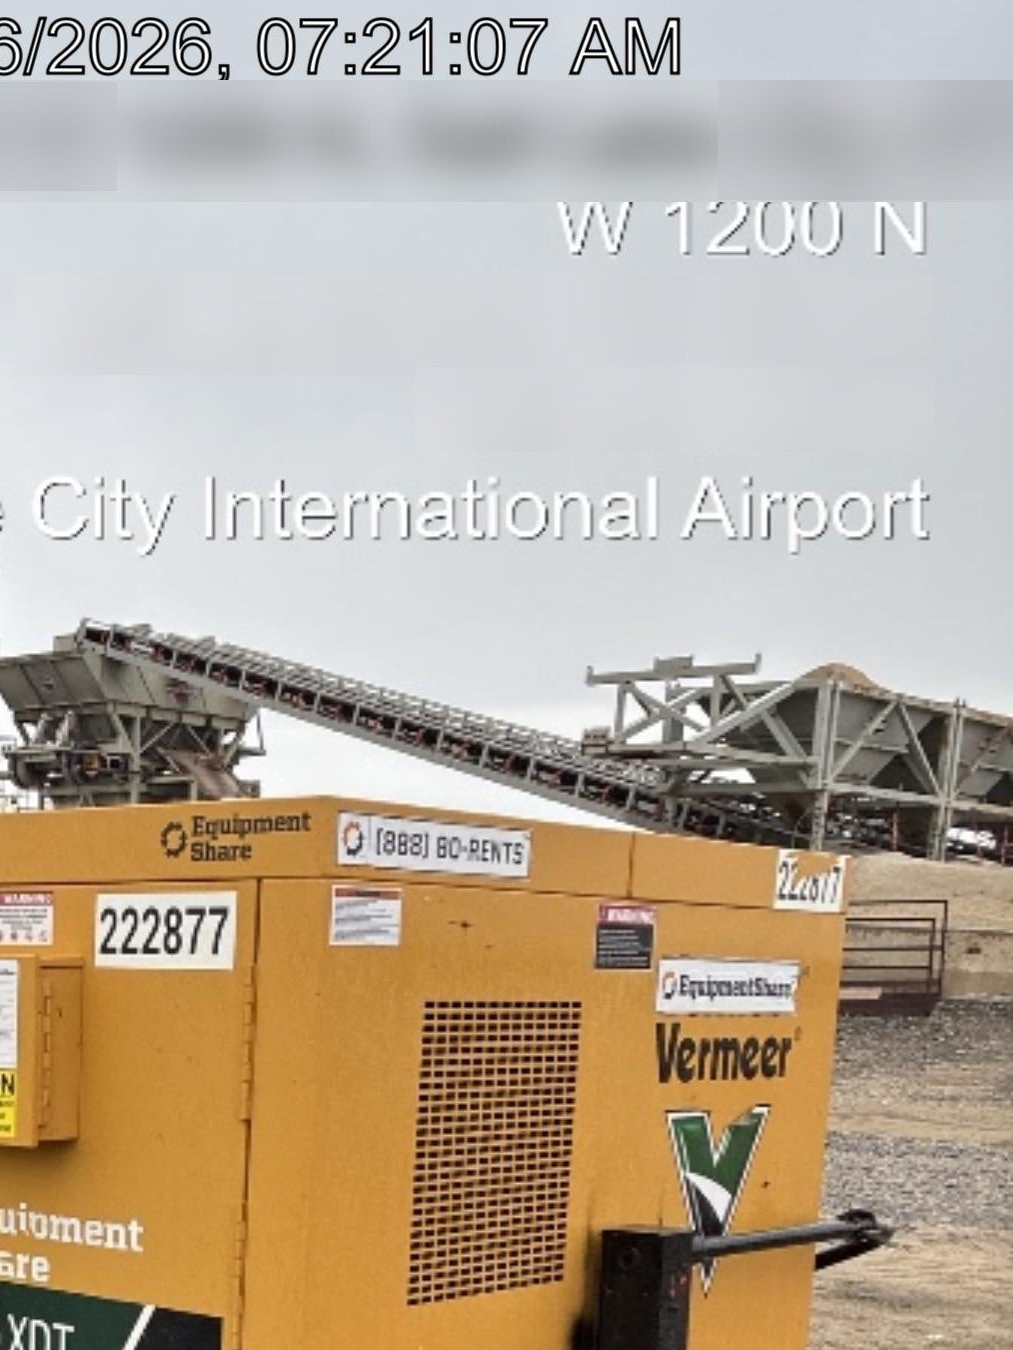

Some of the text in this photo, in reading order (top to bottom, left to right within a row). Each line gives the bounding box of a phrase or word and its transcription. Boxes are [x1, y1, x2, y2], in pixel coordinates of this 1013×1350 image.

[191, 813, 311, 838] Equipment
[190, 841, 252, 862] Share
[99, 906, 229, 957] 222877
[655, 1021, 793, 1084] Vermeer
